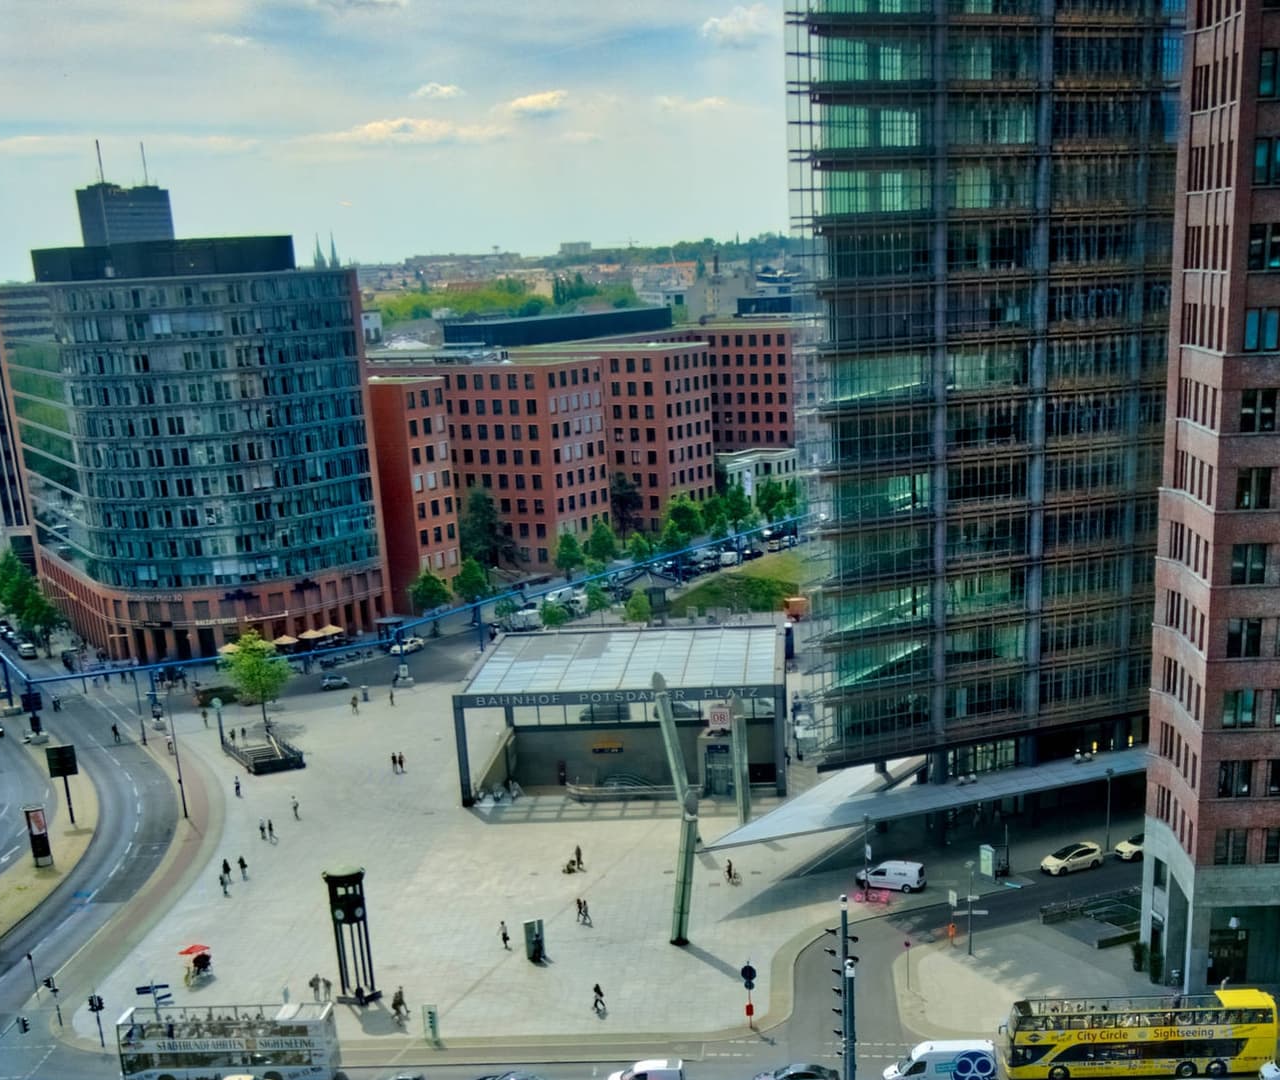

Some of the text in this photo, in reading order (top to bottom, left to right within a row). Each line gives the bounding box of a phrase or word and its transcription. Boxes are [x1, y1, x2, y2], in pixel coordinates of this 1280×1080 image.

[476, 694, 560, 706] BAHNHOF
[704, 687, 758, 699] PLATZ
[1077, 1031, 1097, 1042] City
[1100, 1030, 1128, 1040] Circle
[1154, 1029, 1214, 1039] Sightseeing
[259, 1038, 315, 1049] SIGHTSEEING
